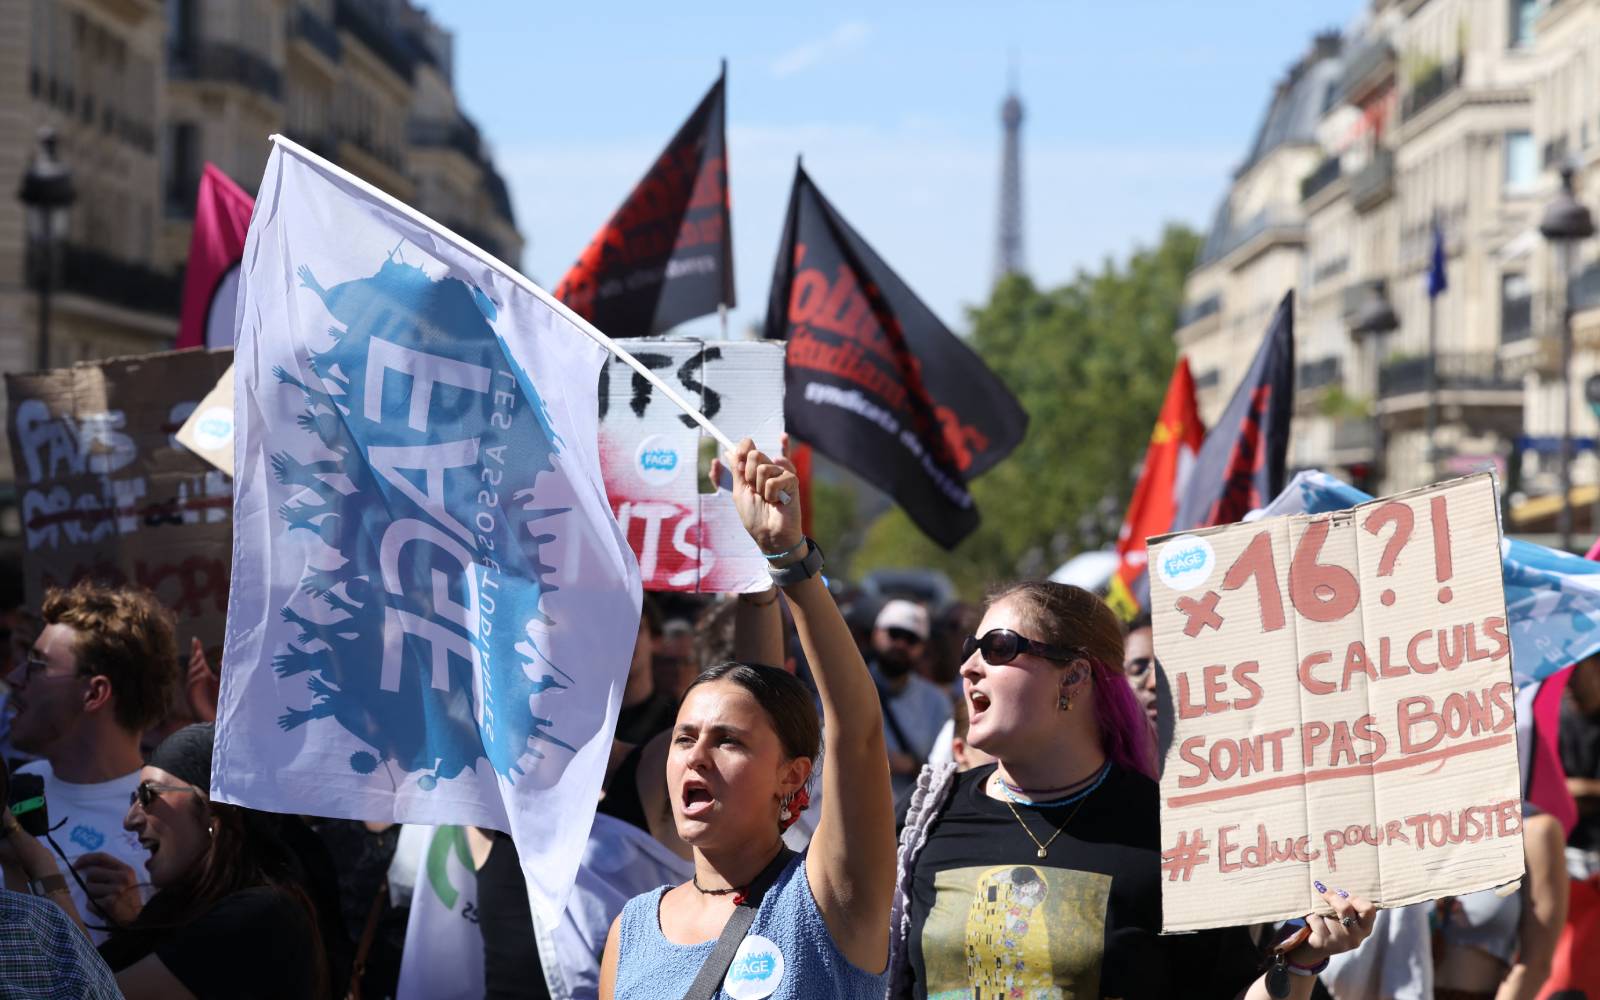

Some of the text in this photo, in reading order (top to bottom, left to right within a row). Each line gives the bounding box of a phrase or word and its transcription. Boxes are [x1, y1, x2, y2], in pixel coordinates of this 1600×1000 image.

[644, 454, 674, 466] FAGE
[1167, 551, 1203, 573] FAGE
[1176, 660, 1265, 720] LES
[1297, 616, 1511, 696] CALCULS
[1177, 682, 1517, 789] SONT PAS BONS
[733, 959, 770, 977] FAGE
